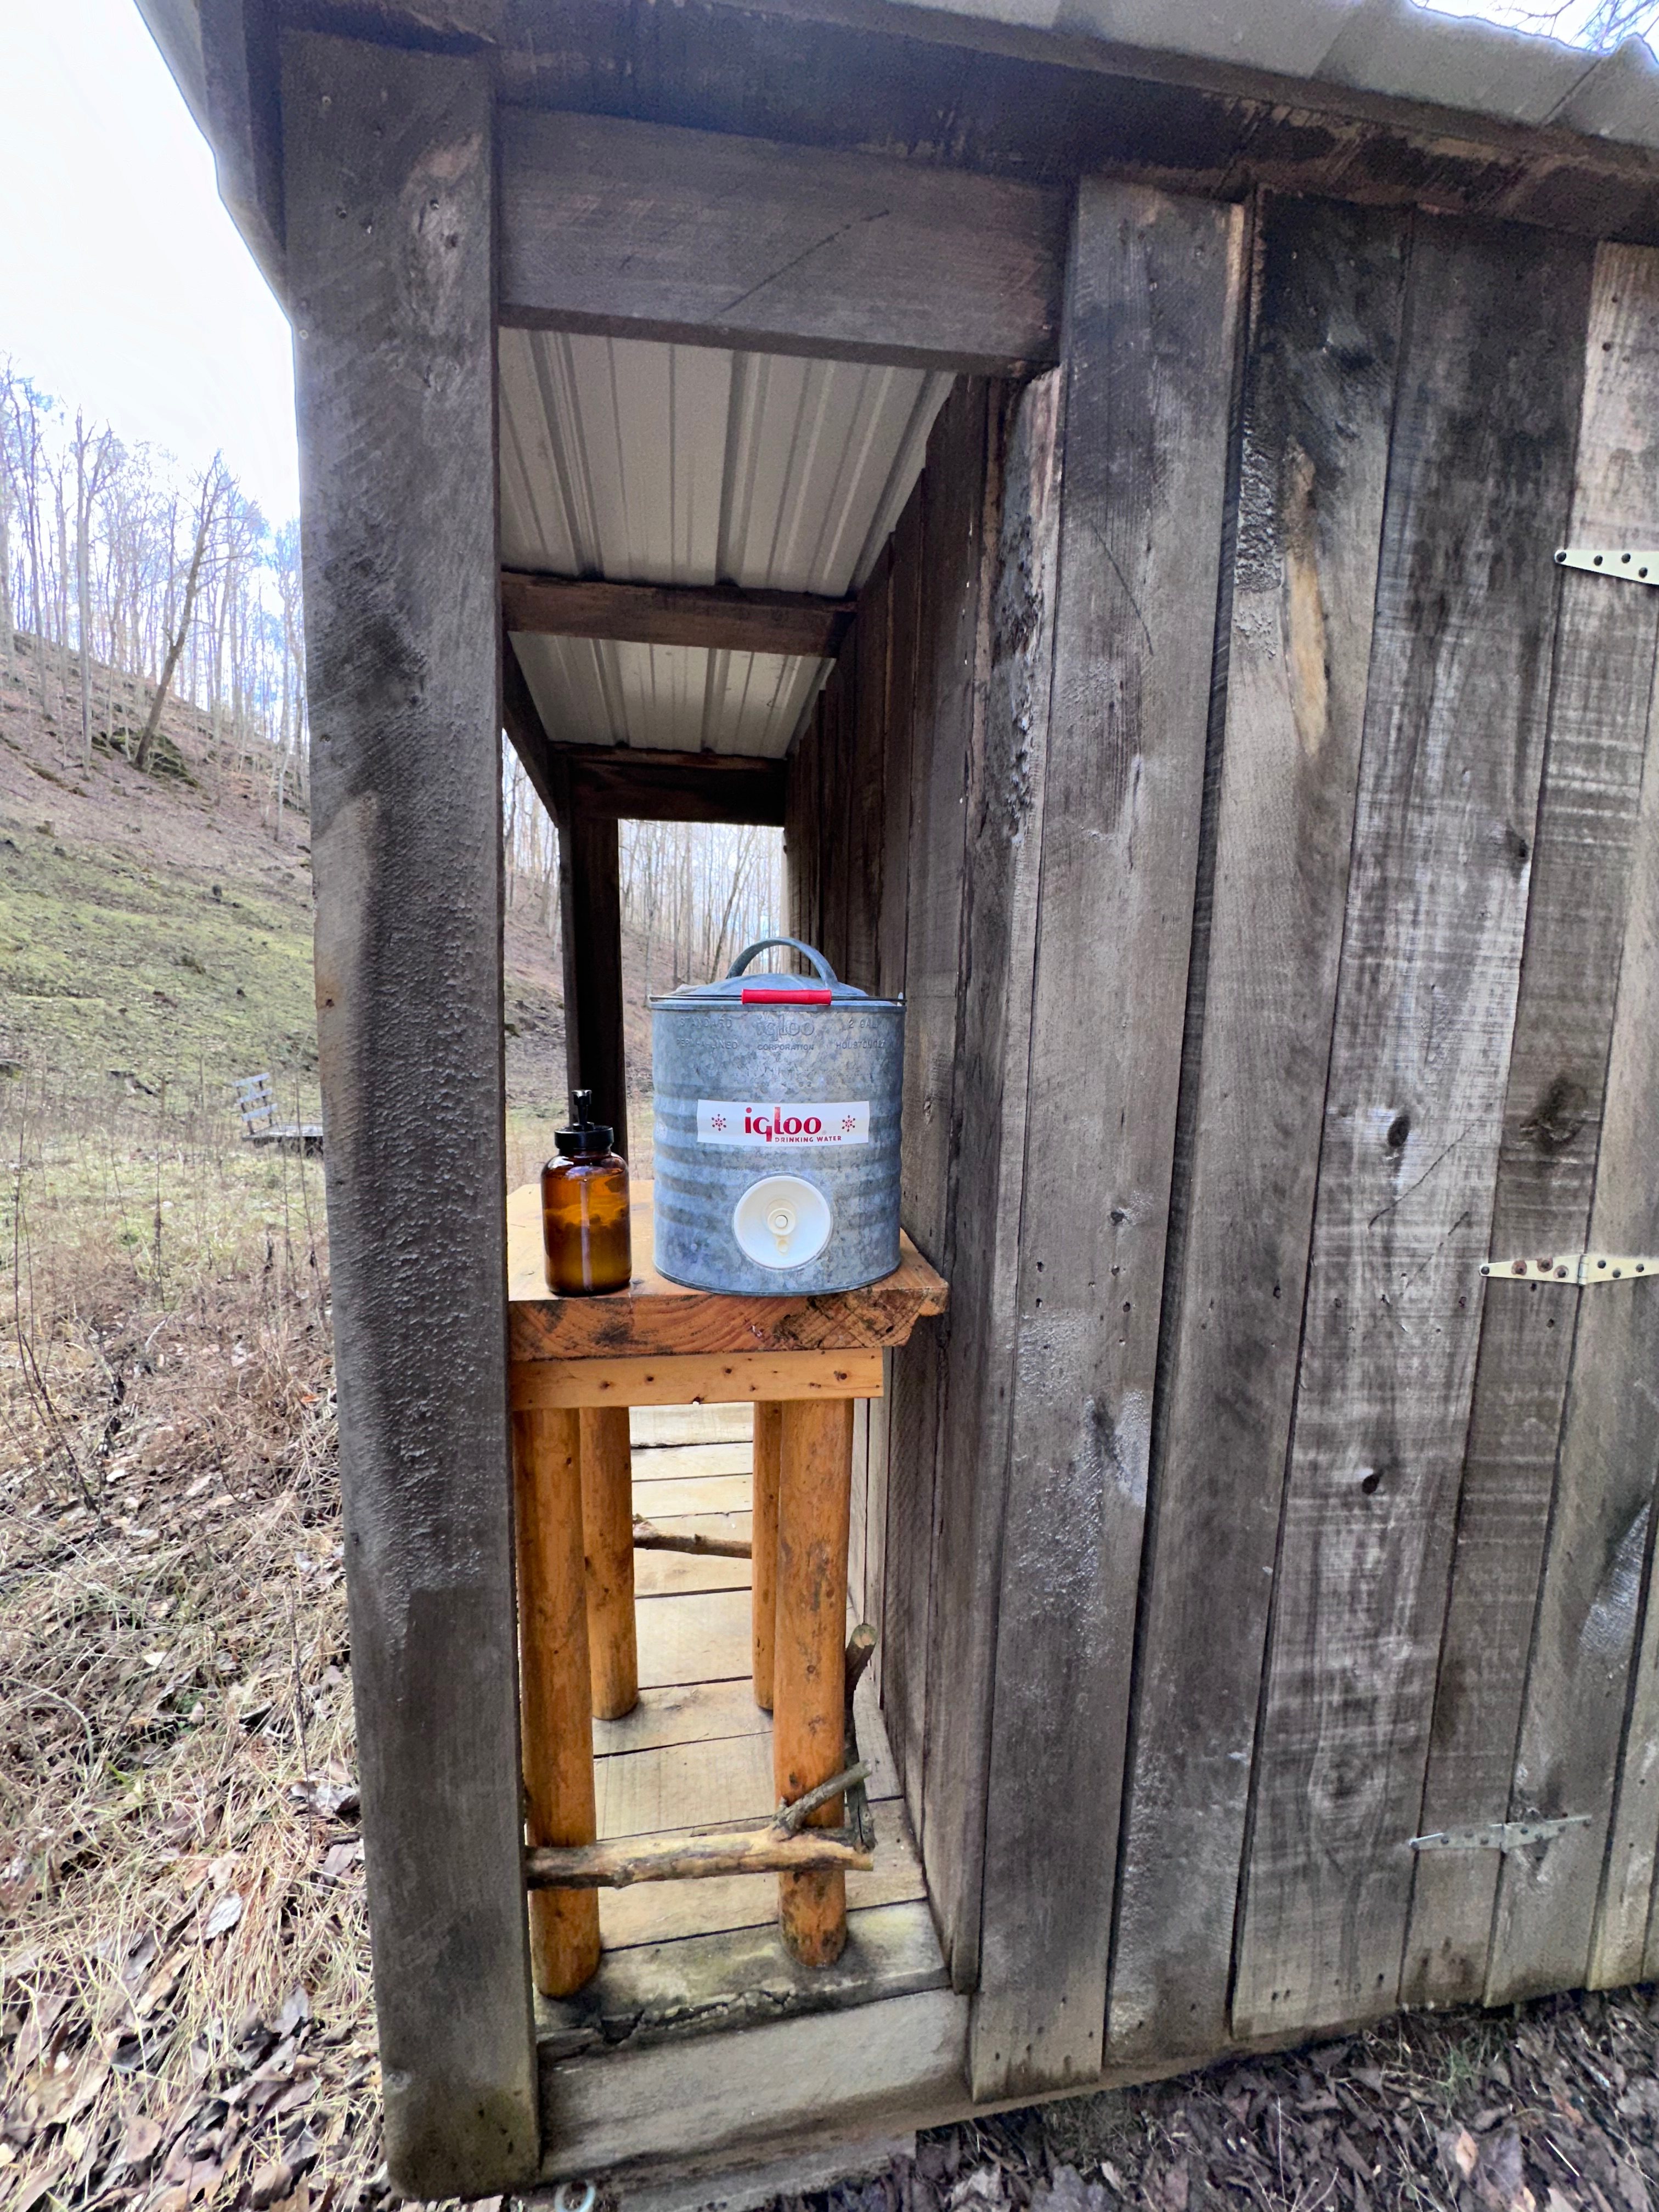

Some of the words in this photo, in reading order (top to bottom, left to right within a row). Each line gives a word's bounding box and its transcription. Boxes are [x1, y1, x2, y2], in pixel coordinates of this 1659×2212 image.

[680, 1016, 733, 1028] STANDARD
[756, 1013, 815, 1041] igloo
[848, 1018, 854, 1028] 2
[744, 1107, 822, 1142] igloo
